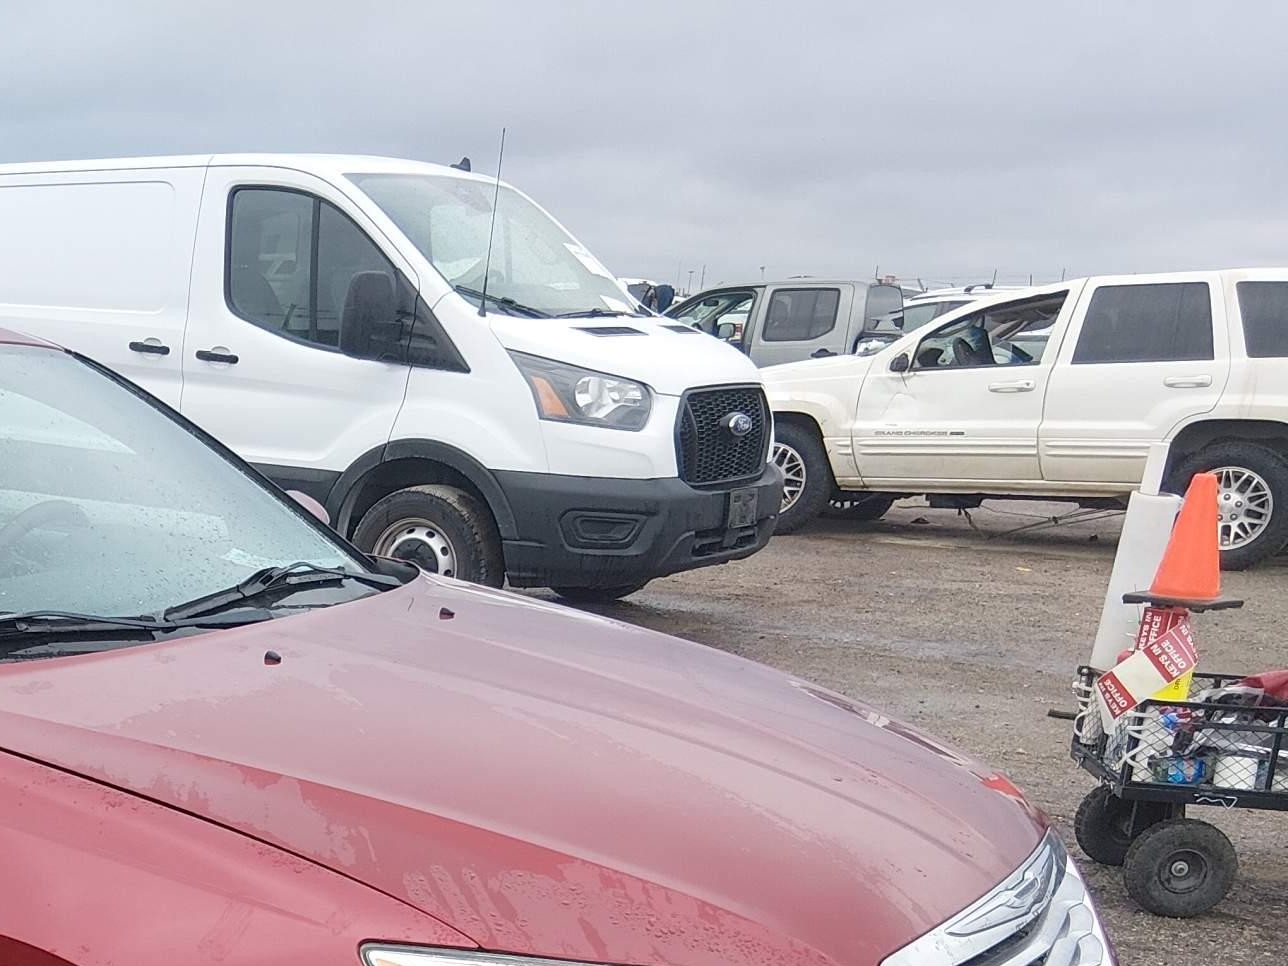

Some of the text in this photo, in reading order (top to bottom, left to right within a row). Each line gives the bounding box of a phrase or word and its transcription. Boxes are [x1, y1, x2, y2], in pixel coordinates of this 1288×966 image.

[1138, 611, 1153, 650] KEYS IN
[1150, 644, 1162, 655] IN
[1160, 639, 1187, 669] OFFICE
[1158, 654, 1181, 678] KEYS
[1103, 678, 1128, 708] OFFICE
